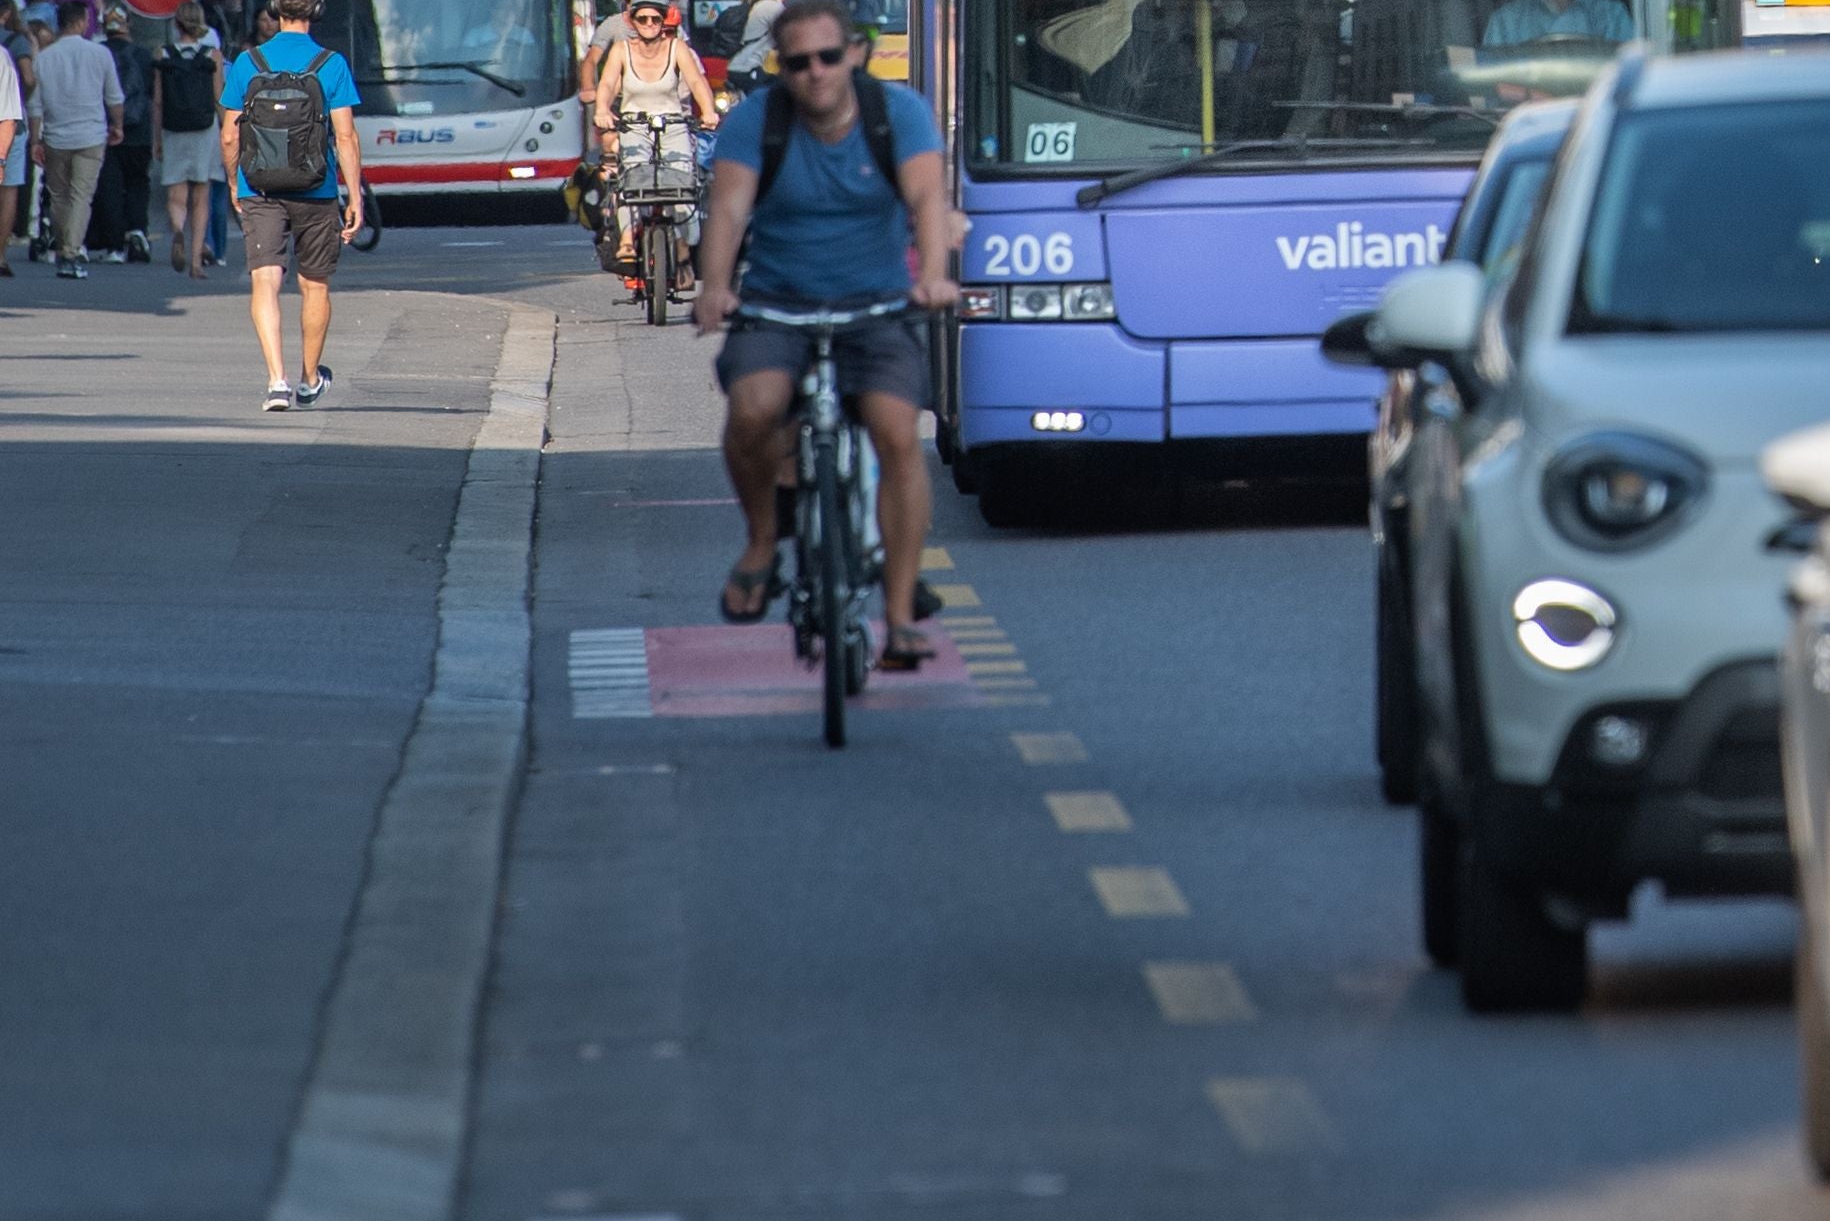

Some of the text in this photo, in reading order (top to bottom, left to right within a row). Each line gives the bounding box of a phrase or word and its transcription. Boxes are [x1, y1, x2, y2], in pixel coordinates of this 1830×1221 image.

[1030, 130, 1072, 158] 06
[984, 232, 1075, 276] 206
[1276, 221, 1445, 270] valiant
